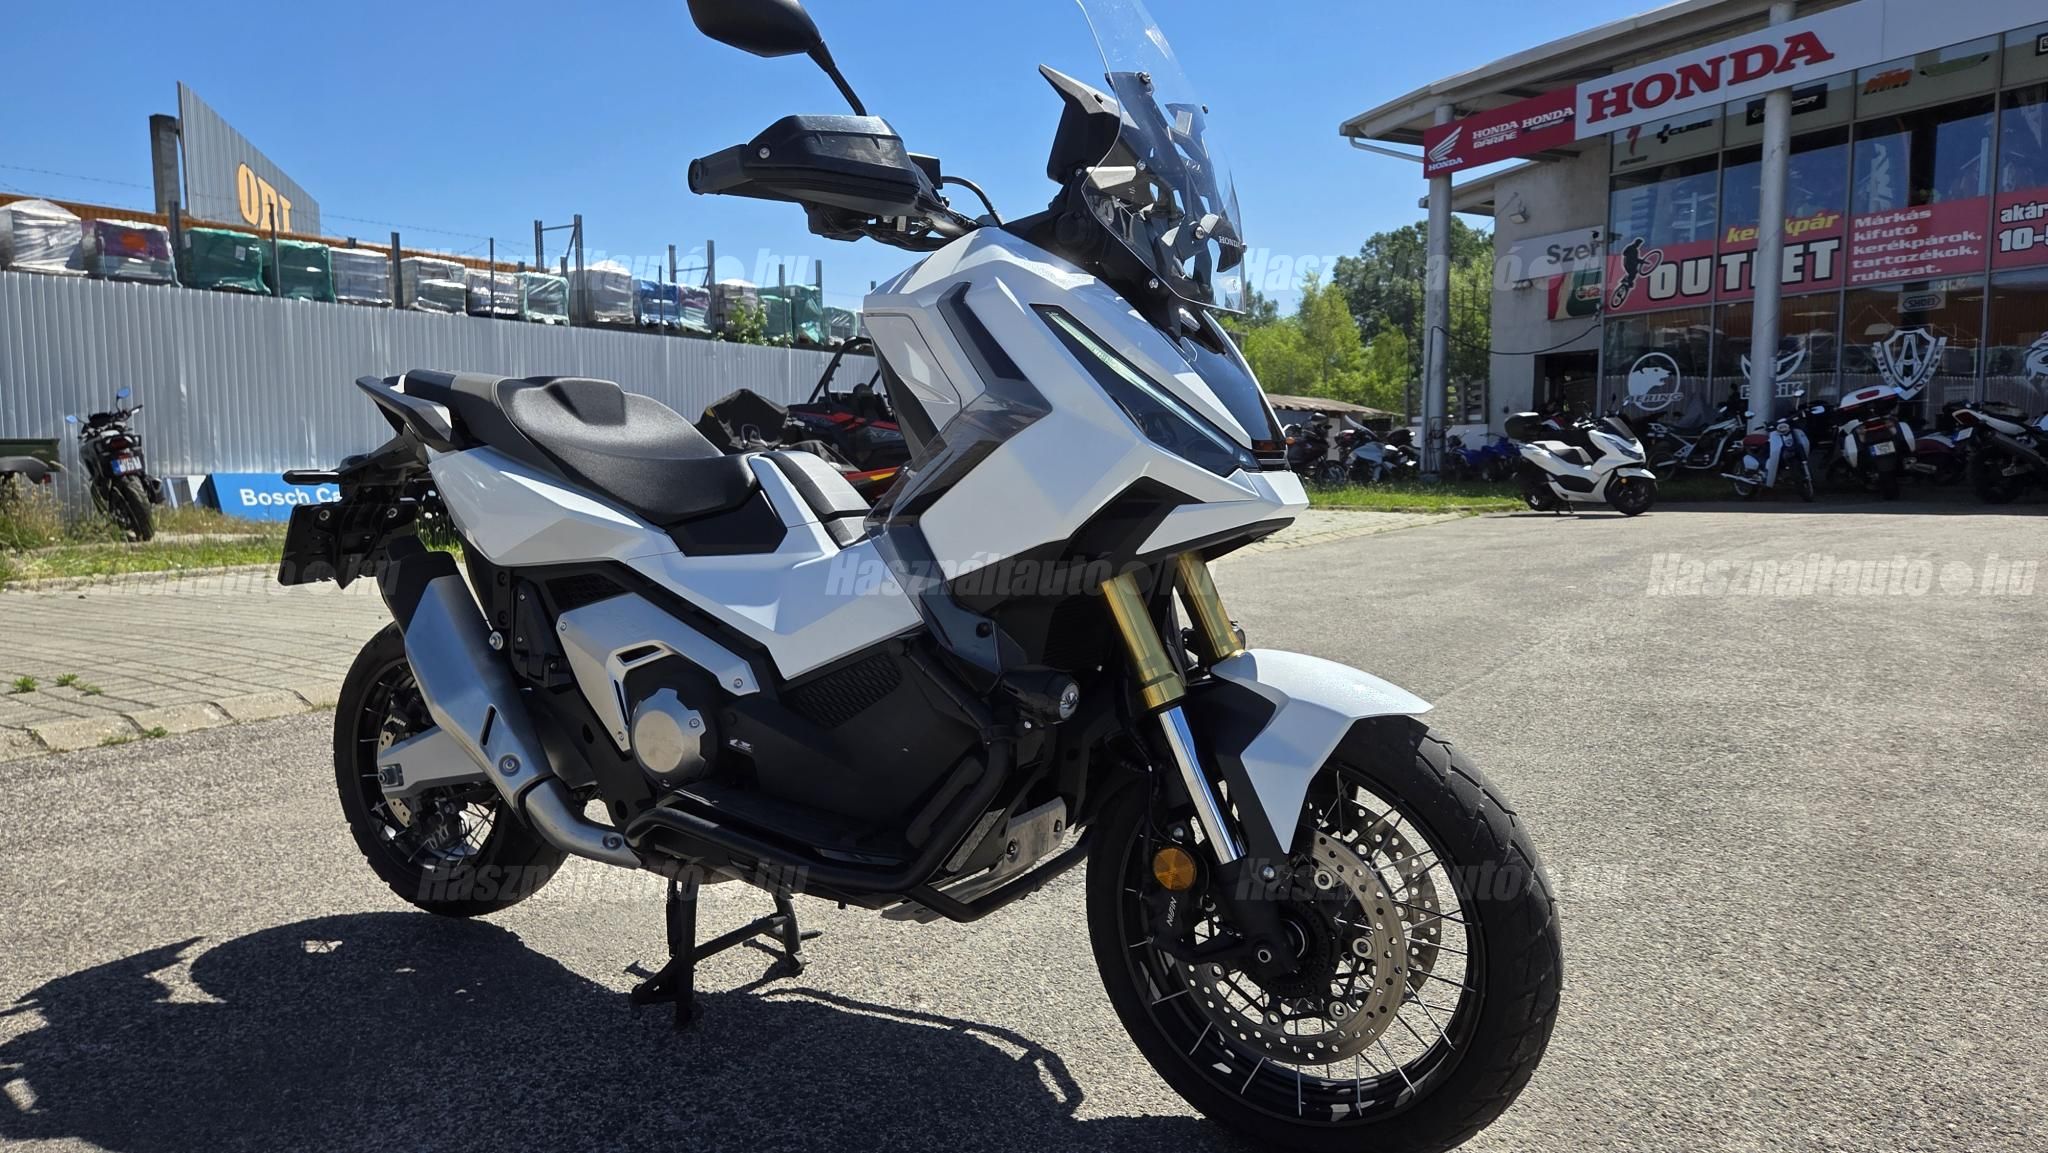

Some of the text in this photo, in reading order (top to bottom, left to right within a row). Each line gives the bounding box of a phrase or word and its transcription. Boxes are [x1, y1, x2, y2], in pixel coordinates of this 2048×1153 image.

[1585, 30, 1836, 125] HONDA
[1522, 107, 1575, 129] HONDA
[1472, 120, 1519, 139] HONDA
[1473, 132, 1518, 149] MARINE
[1428, 157, 1464, 171] HONDA
[1854, 209, 1932, 228] Márkás
[2000, 202, 2048, 223] akár
[1726, 212, 1840, 243] kekpár
[1854, 223, 1918, 241] kifutó
[1219, 236, 1241, 248] HOND
[1853, 230, 1982, 255] kerékpárok,
[1999, 224, 2048, 252] 10-
[1853, 245, 1979, 269] tartozékok,
[1851, 264, 1942, 282] ruházat.
[240, 487, 311, 506] Bosch
